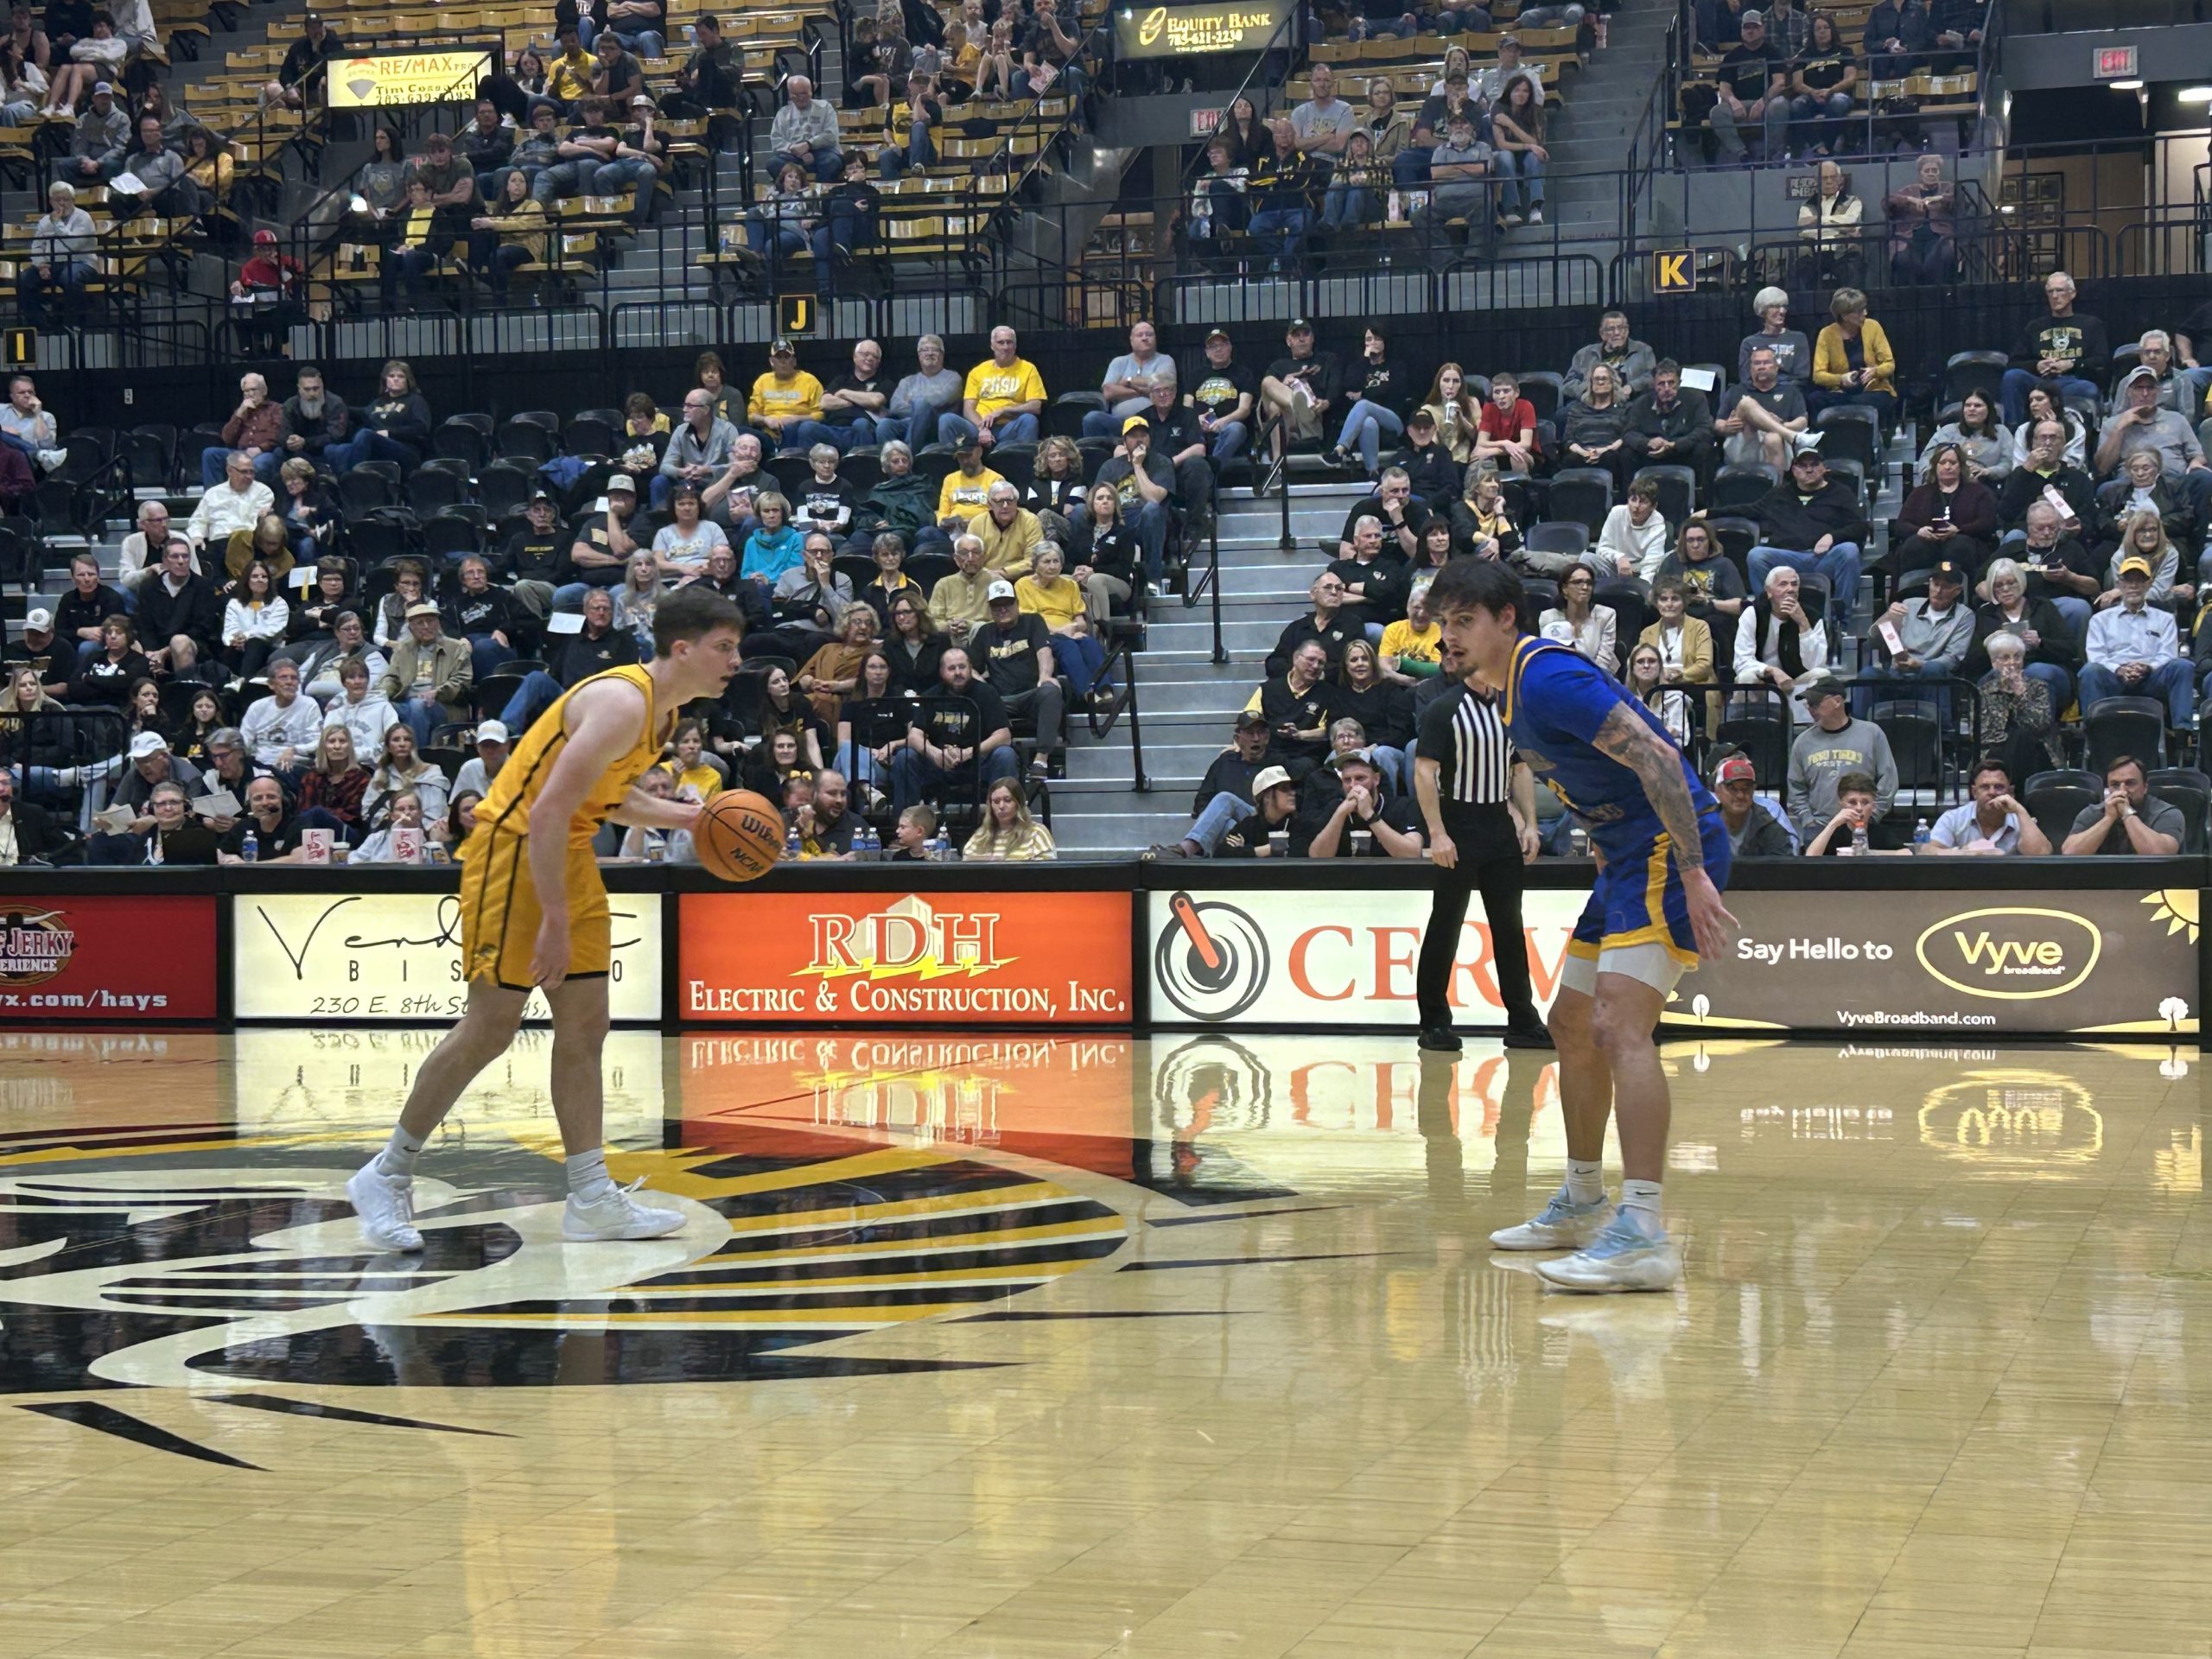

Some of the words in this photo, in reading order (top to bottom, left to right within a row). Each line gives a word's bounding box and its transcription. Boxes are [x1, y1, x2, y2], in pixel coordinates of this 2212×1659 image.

[380, 56, 453, 75] RE/MAX
[1660, 254, 1689, 287] K
[790, 300, 806, 330] J
[7, 927, 74, 957] JERKY
[809, 913, 1000, 969] RDH
[1737, 938, 1784, 965] Say
[1789, 937, 1859, 960] Hello
[1863, 939, 1893, 960] to
[1955, 931, 2063, 975] Vyve
[0, 958, 58, 972] ERIENCE
[310, 995, 359, 1014] 230
[400, 994, 442, 1014] 8th
[690, 981, 804, 1012] ELECTRIC
[815, 981, 837, 1012] &
[850, 981, 1058, 1018] CONSTRUCTION,
[1068, 981, 1126, 1012] INC.
[1836, 1010, 1997, 1027] VyveBroadband.com
